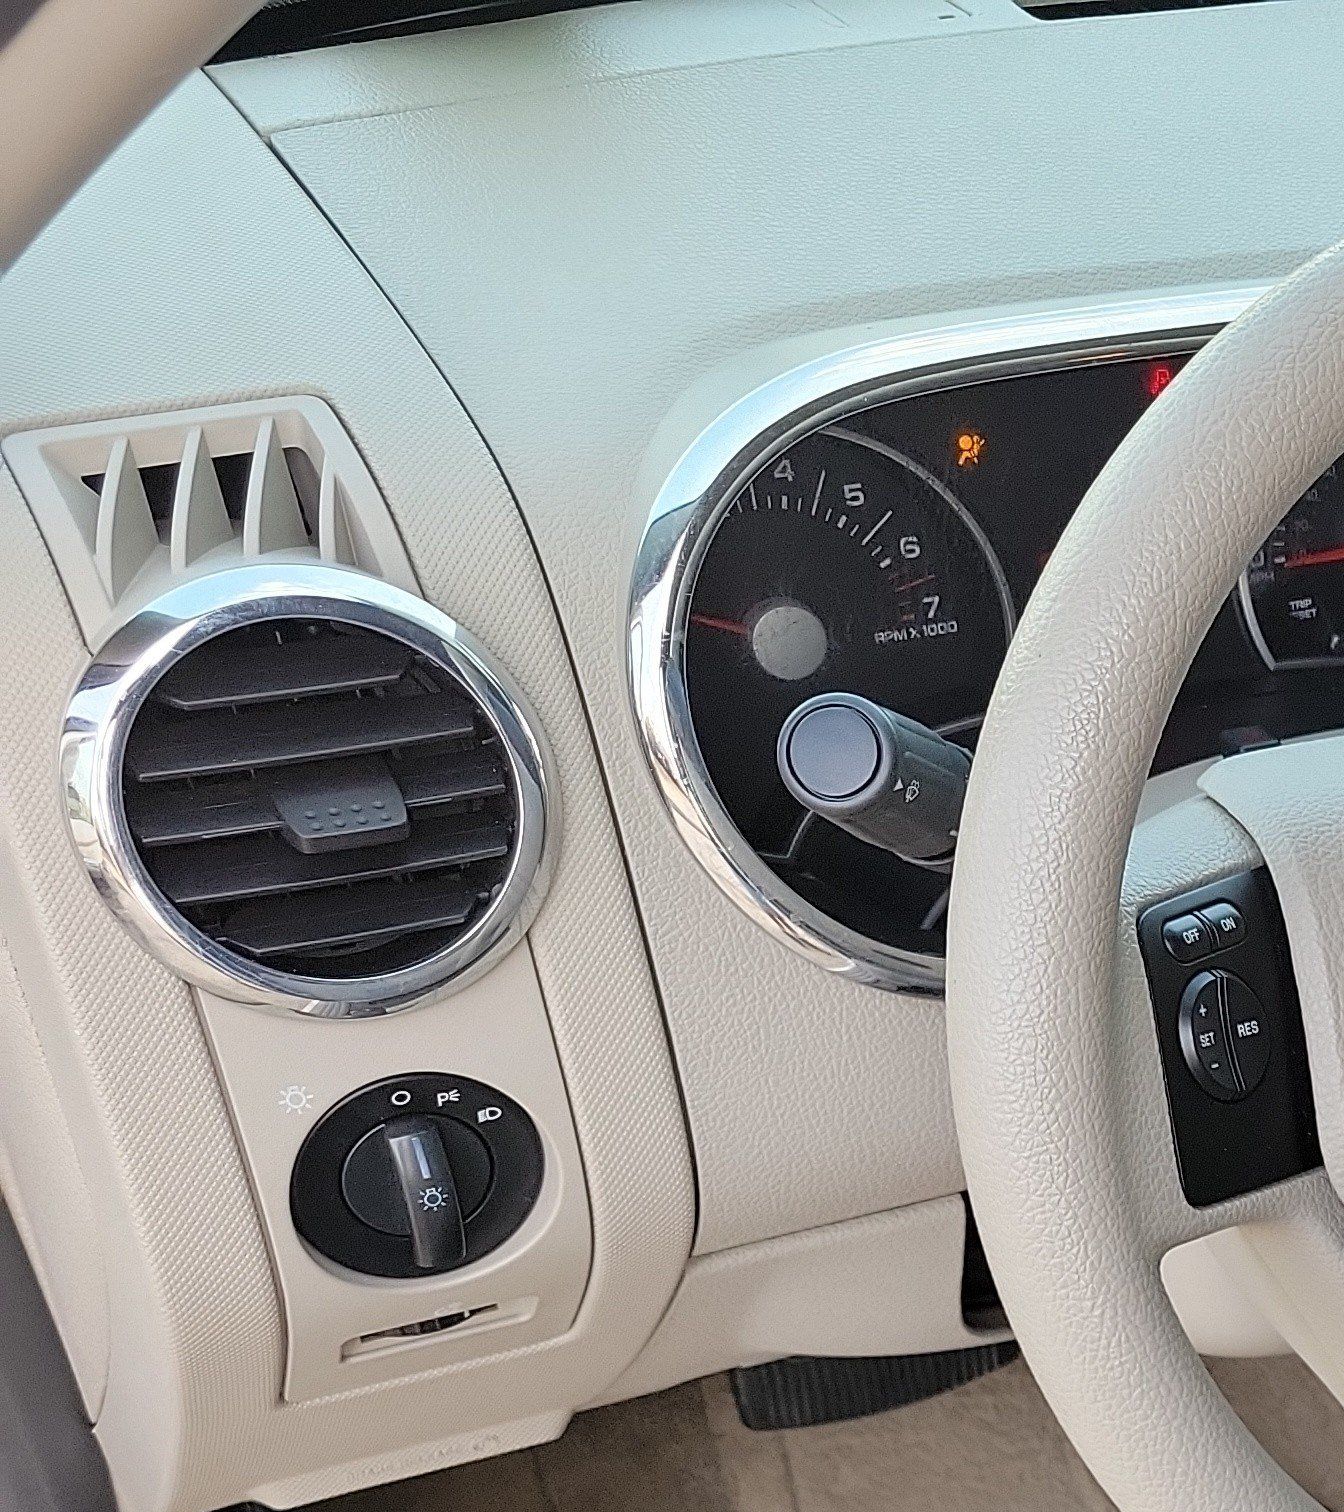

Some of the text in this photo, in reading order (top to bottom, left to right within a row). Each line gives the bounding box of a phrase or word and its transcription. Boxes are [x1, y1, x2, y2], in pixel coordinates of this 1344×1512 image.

[774, 460, 795, 482] 4
[843, 483, 865, 507] 5
[900, 536, 921, 559] 6
[922, 595, 940, 619] 7
[874, 629, 908, 644] RPM
[922, 621, 958, 637] 1000
[1182, 916, 1237, 944] OFF ON
[1200, 1031, 1216, 1047] SET
[1237, 1020, 1260, 1036] RES
